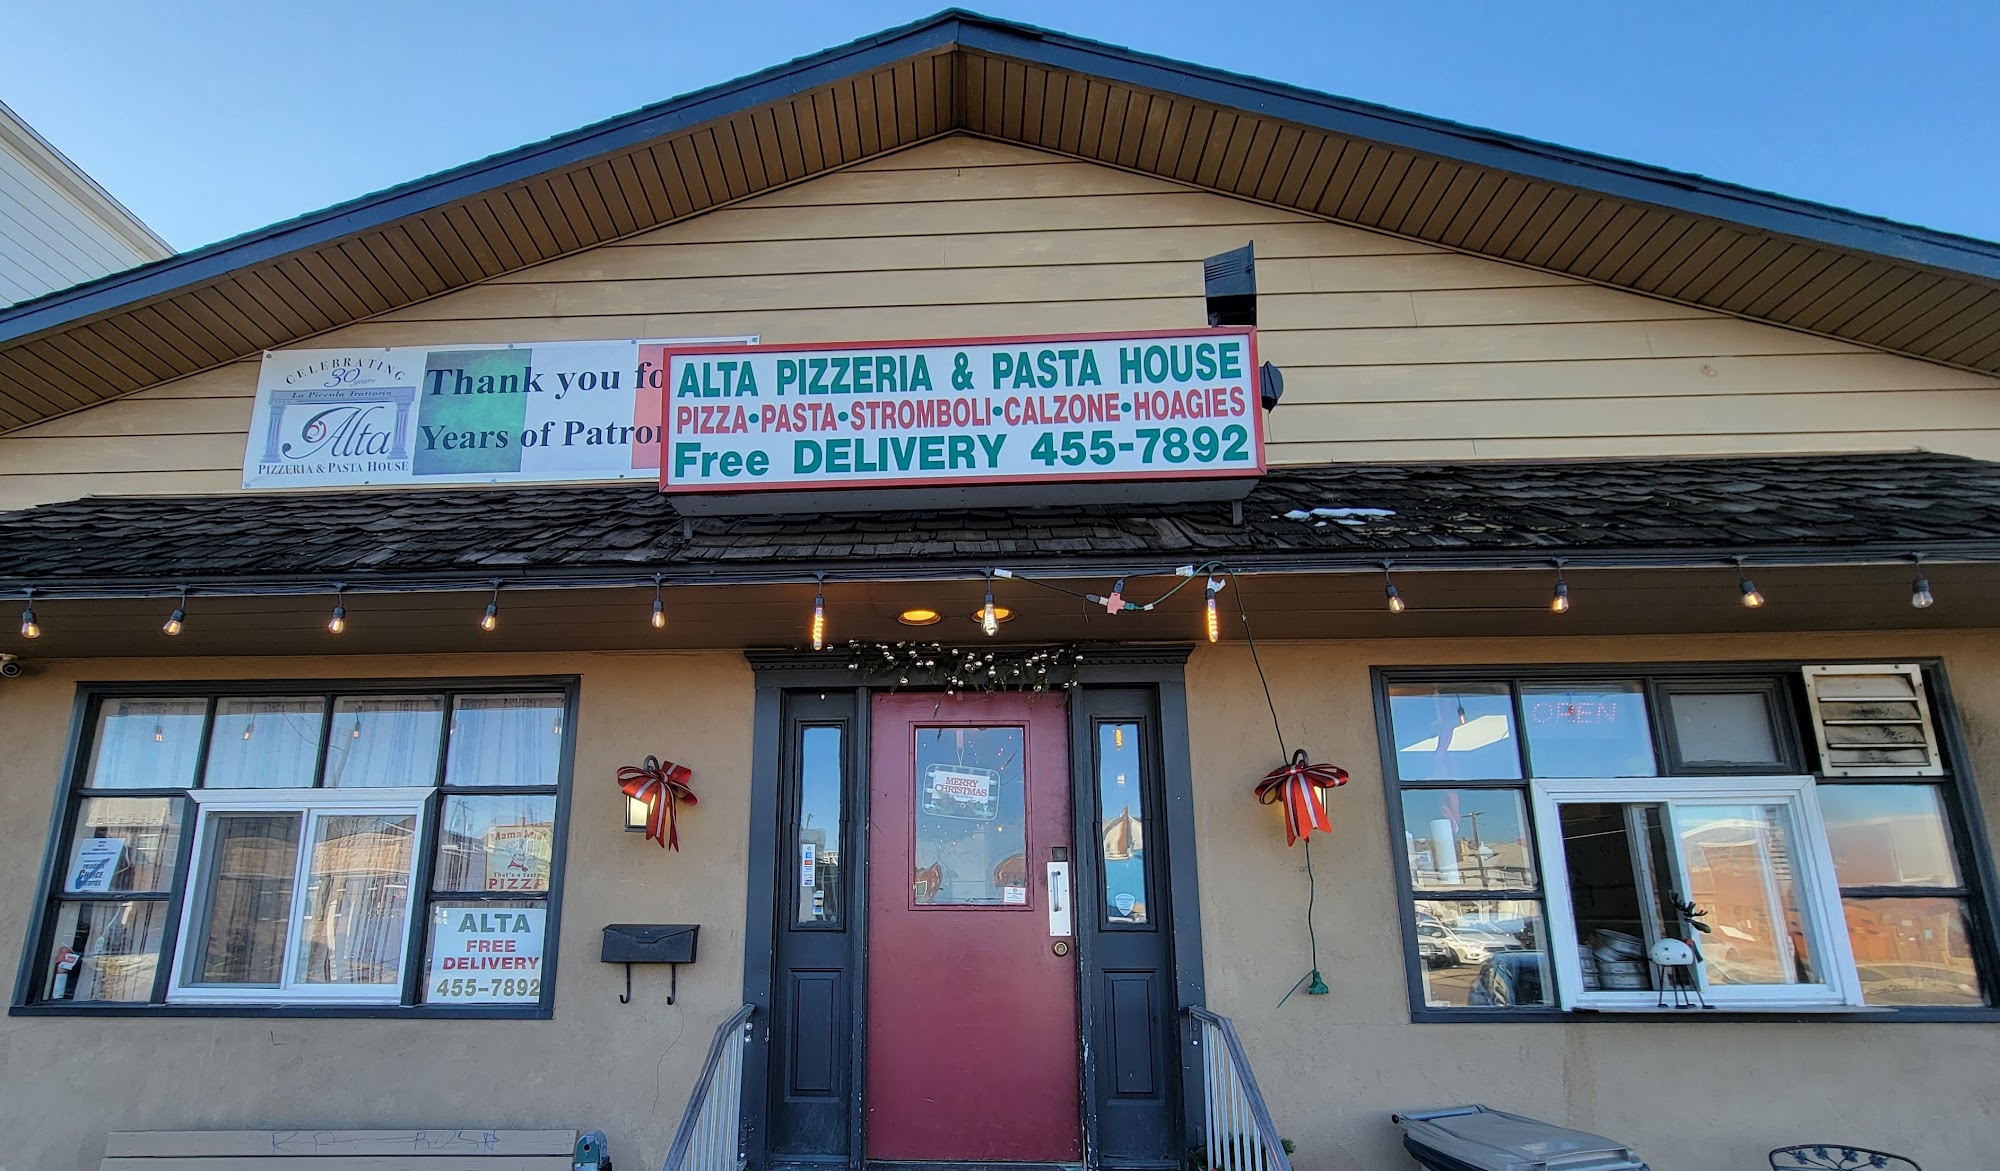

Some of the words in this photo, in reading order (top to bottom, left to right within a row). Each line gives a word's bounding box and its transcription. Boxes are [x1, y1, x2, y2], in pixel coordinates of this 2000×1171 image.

[285, 357, 406, 385] CELEBRATING
[323, 367, 361, 388] 30
[354, 377, 376, 387] years
[677, 361, 758, 398] ALTA
[776, 354, 933, 396] PIZZERIA
[951, 351, 975, 391] &
[992, 349, 1102, 390] PASTA
[1119, 342, 1242, 384] HOUSE
[426, 366, 544, 396] Thank
[555, 370, 620, 400] you
[676, 405, 748, 434] PIZZA
[761, 402, 837, 433] PASTA
[850, 396, 991, 431] STROMBOLI
[1004, 392, 1121, 427] CALZONE
[1133, 386, 1246, 423] HOAGIES
[281, 406, 392, 460] Alta
[420, 424, 509, 450] Years
[520, 421, 555, 447] of
[675, 442, 770, 478] Free
[794, 433, 1008, 474] DELIVERY
[1030, 424, 1249, 467] 455-7892
[257, 463, 313, 475] PIZZERIA
[316, 464, 325, 473] &
[328, 462, 363, 473] PASTA
[367, 460, 409, 472] HOUSE
[1532, 702, 1616, 724] OPEN
[935, 783, 988, 797] CHRISTMAS
[945, 776, 979, 788] MERRY
[490, 831, 521, 841] Mama
[489, 878, 546, 890] PIZZA
[457, 913, 531, 933] ALTA
[466, 940, 516, 953] FREE
[442, 957, 539, 970] DELIVERY
[436, 978, 540, 997] 455-7892
